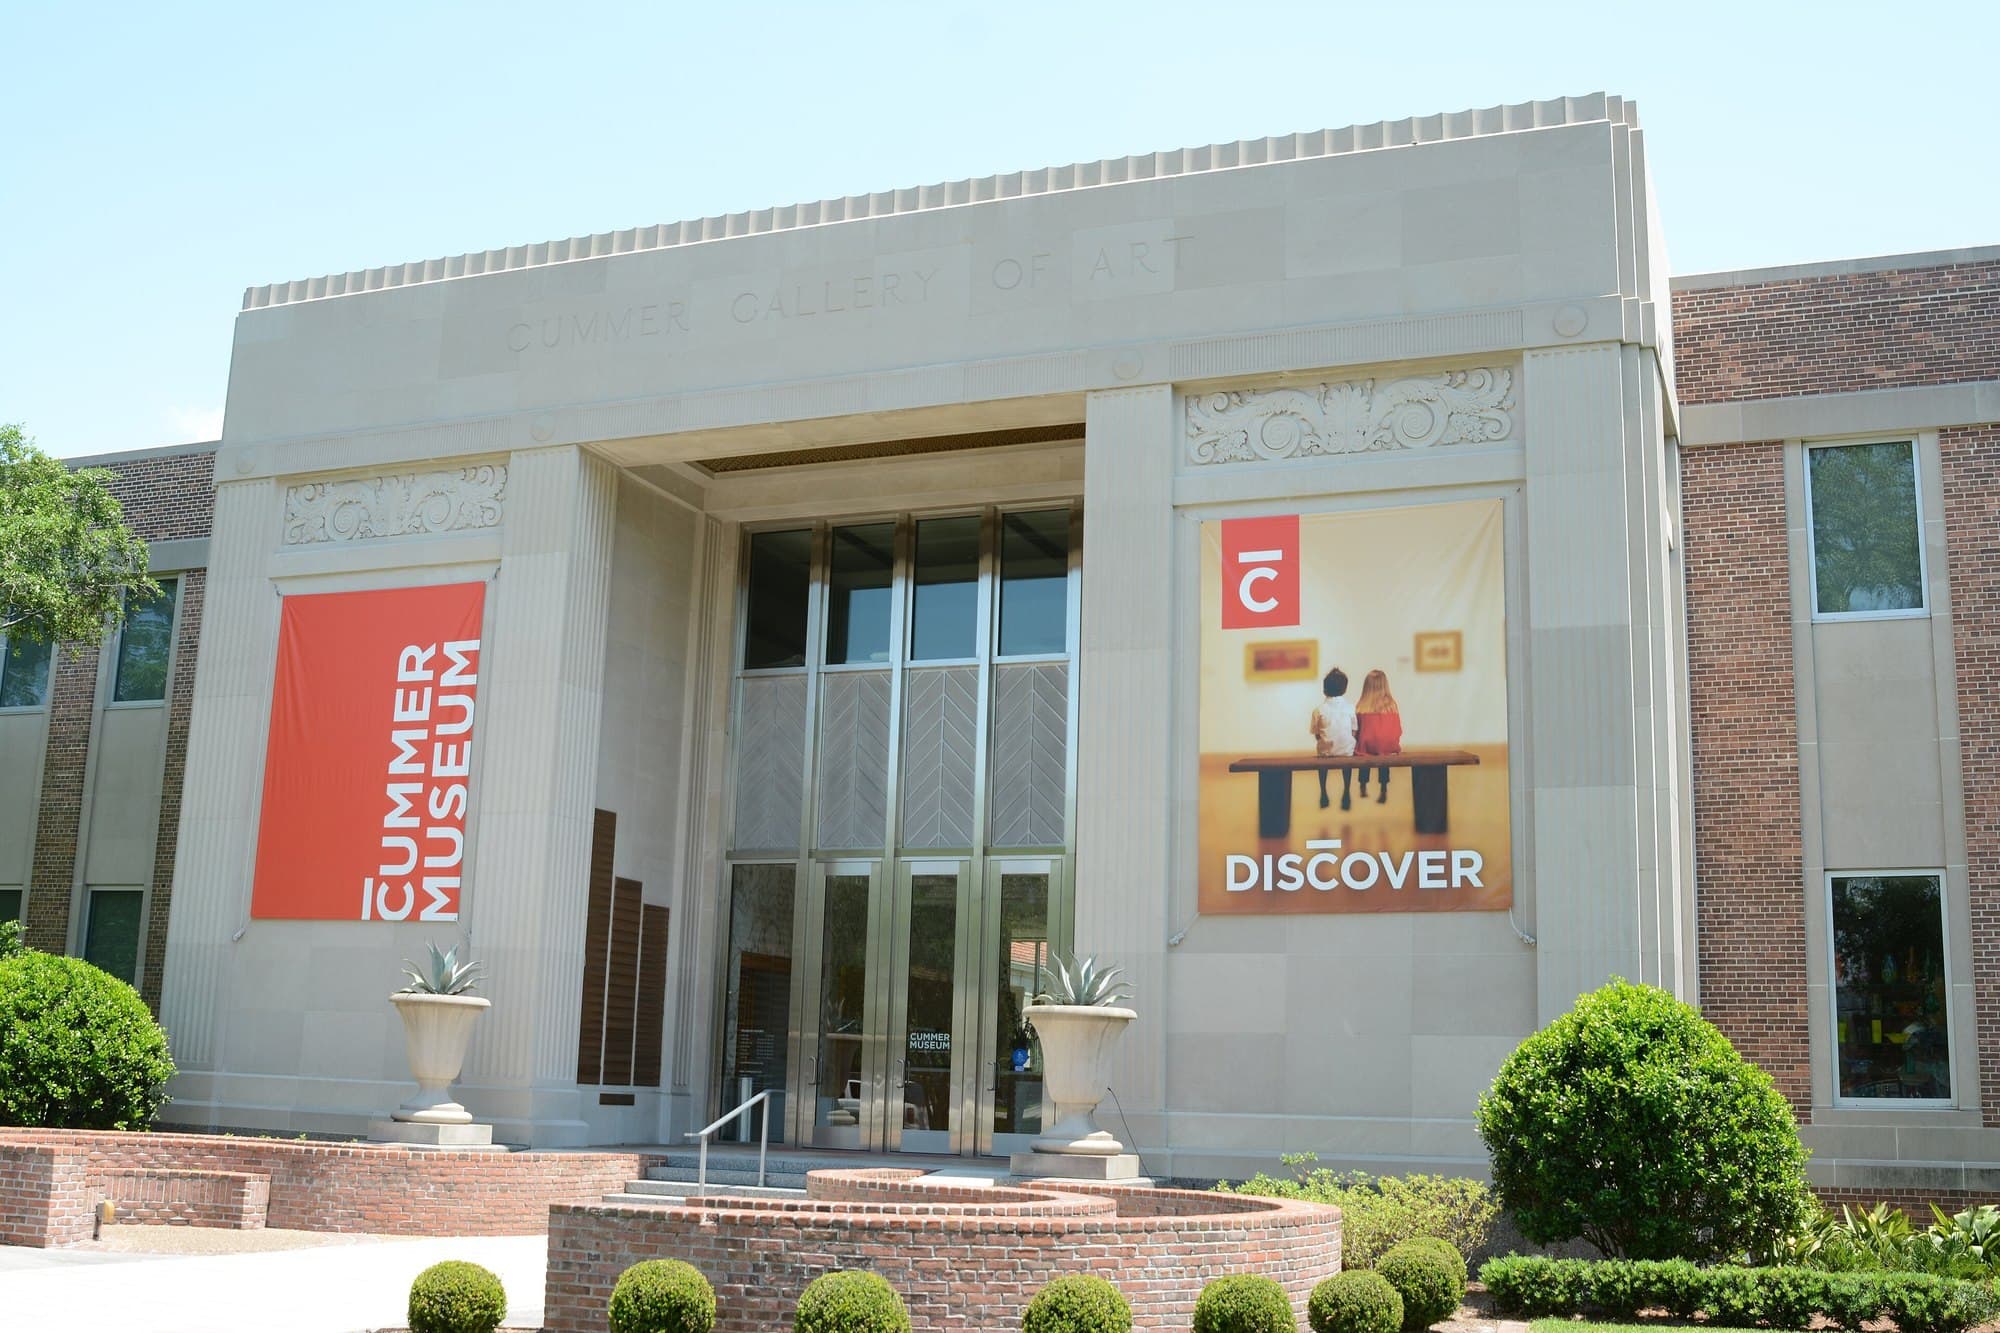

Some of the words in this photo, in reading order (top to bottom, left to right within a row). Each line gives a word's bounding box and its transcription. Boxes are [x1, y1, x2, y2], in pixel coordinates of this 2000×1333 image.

[505, 301, 690, 353] CUMMER
[731, 268, 942, 323] GALLERY
[992, 253, 1050, 290] OF
[1089, 235, 1195, 281] ART
[370, 642, 437, 922] CUMMER
[419, 639, 481, 922] MUSEUM
[1226, 842, 1484, 892] DISCOVER
[910, 1032, 950, 1041] CUMMER
[910, 1040, 950, 1050] MUSEUM
